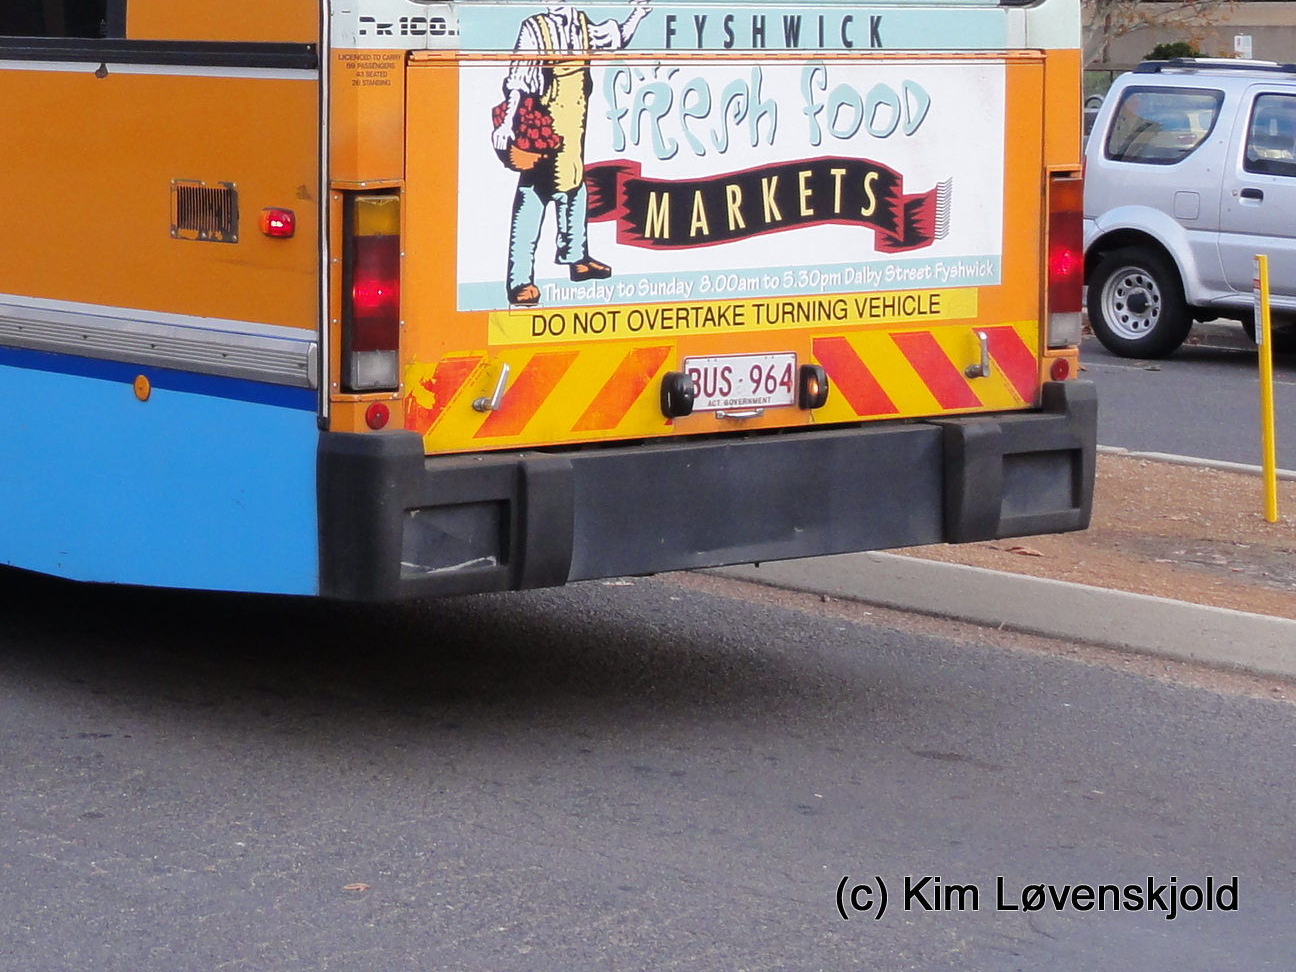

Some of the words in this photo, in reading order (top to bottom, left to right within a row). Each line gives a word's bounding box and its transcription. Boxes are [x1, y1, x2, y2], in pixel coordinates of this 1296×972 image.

[665, 14, 883, 49] FYSHWICK
[338, 53, 371, 61] LICENCED
[372, 53, 381, 61] TO
[382, 53, 402, 61] CARRY
[357, 62, 396, 70] PASSENGERS
[644, 168, 879, 240] MARKETS
[543, 280, 616, 303] Thursday
[617, 281, 636, 297] to
[637, 278, 695, 299] Sunday
[699, 273, 760, 293] 8.00am
[763, 273, 782, 290] to
[783, 268, 842, 293] 5.30pm
[844, 264, 882, 288] Dalby
[885, 262, 933, 281] Street
[934, 259, 994, 283] Fyshwick
[531, 313, 566, 337] DO
[573, 310, 621, 335] NOT
[627, 303, 746, 332] OVERTAKE
[752, 298, 848, 325] TURNING
[854, 293, 941, 319] VEHICLE
[688, 365, 733, 398] BUS
[749, 362, 793, 395] 964
[707, 399, 720, 407] ACT
[724, 396, 772, 406] GOVERNMENT
